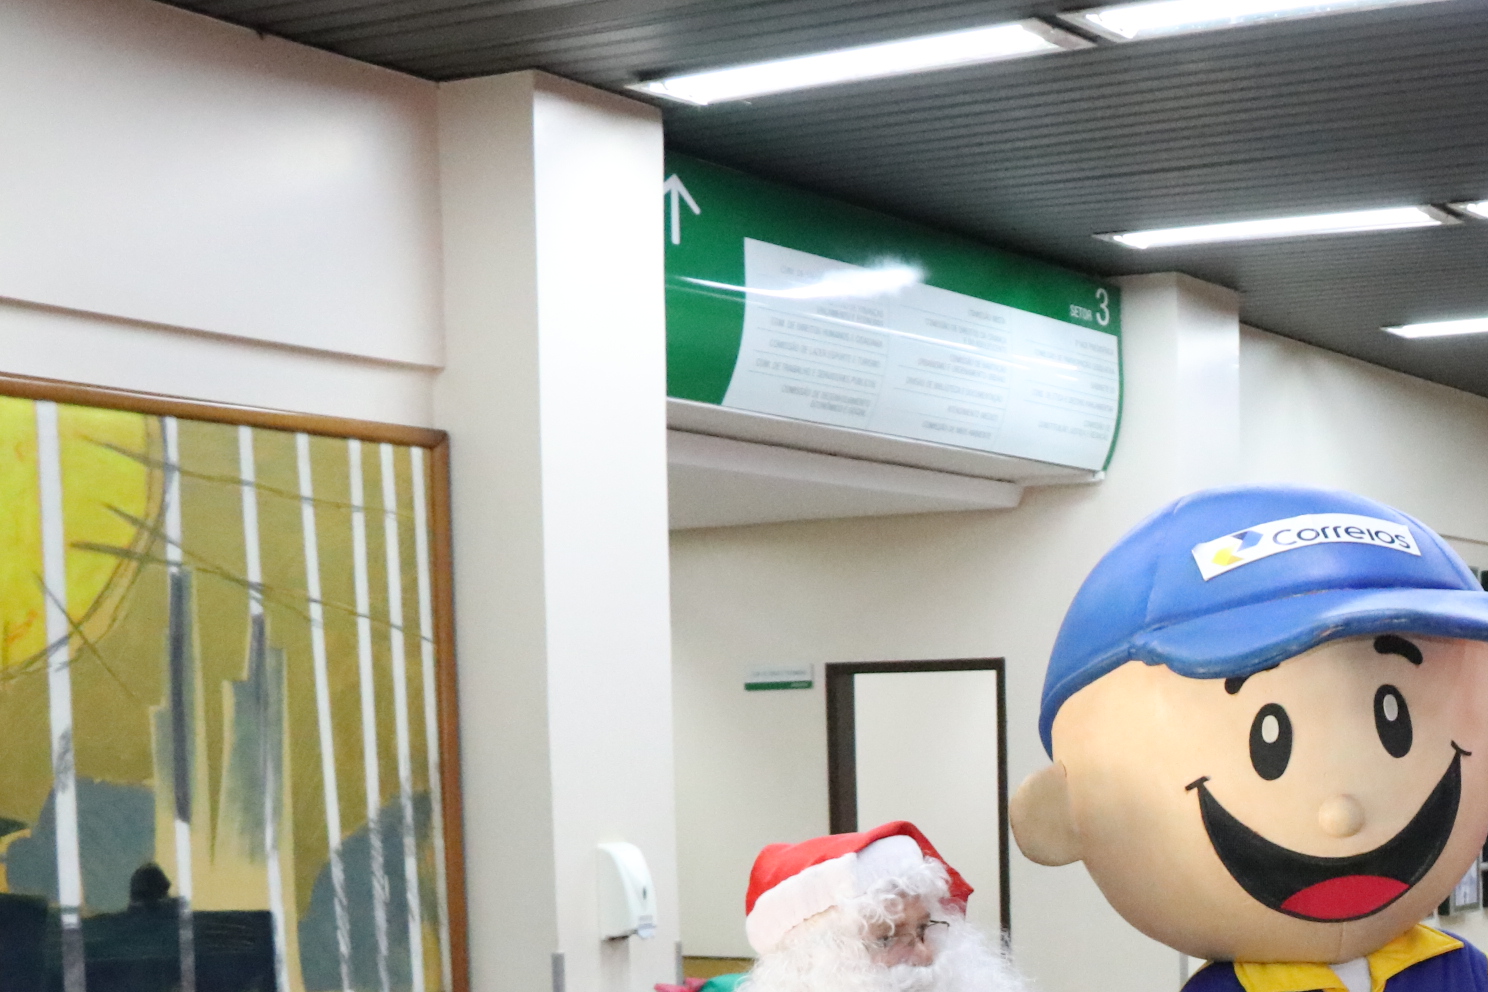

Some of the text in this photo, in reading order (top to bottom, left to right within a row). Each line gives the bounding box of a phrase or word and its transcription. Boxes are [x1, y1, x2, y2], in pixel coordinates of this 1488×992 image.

[1070, 288, 1109, 325] SETOR 3
[1273, 526, 1410, 548] Correios
